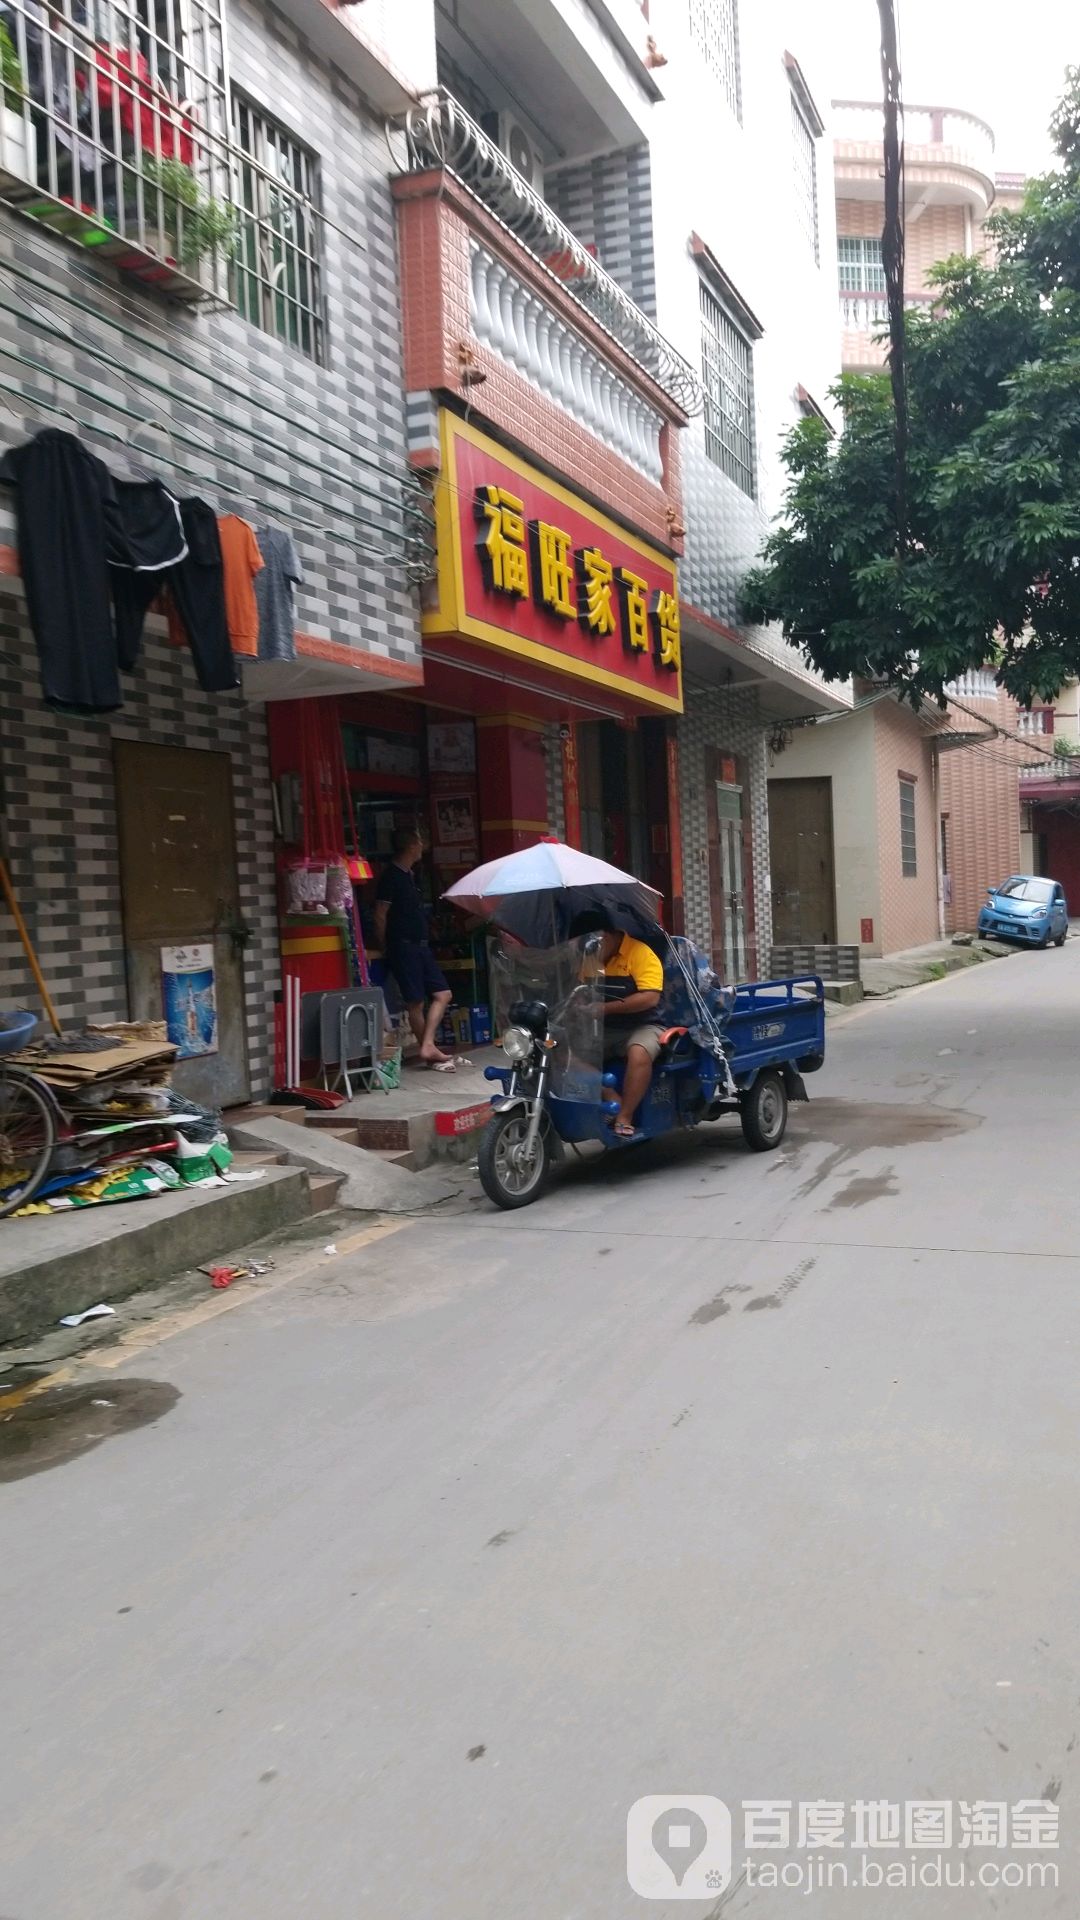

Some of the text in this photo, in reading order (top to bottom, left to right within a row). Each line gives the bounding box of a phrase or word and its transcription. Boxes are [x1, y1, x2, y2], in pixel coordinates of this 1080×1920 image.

[476, 485, 680, 672] 福旺家百货
